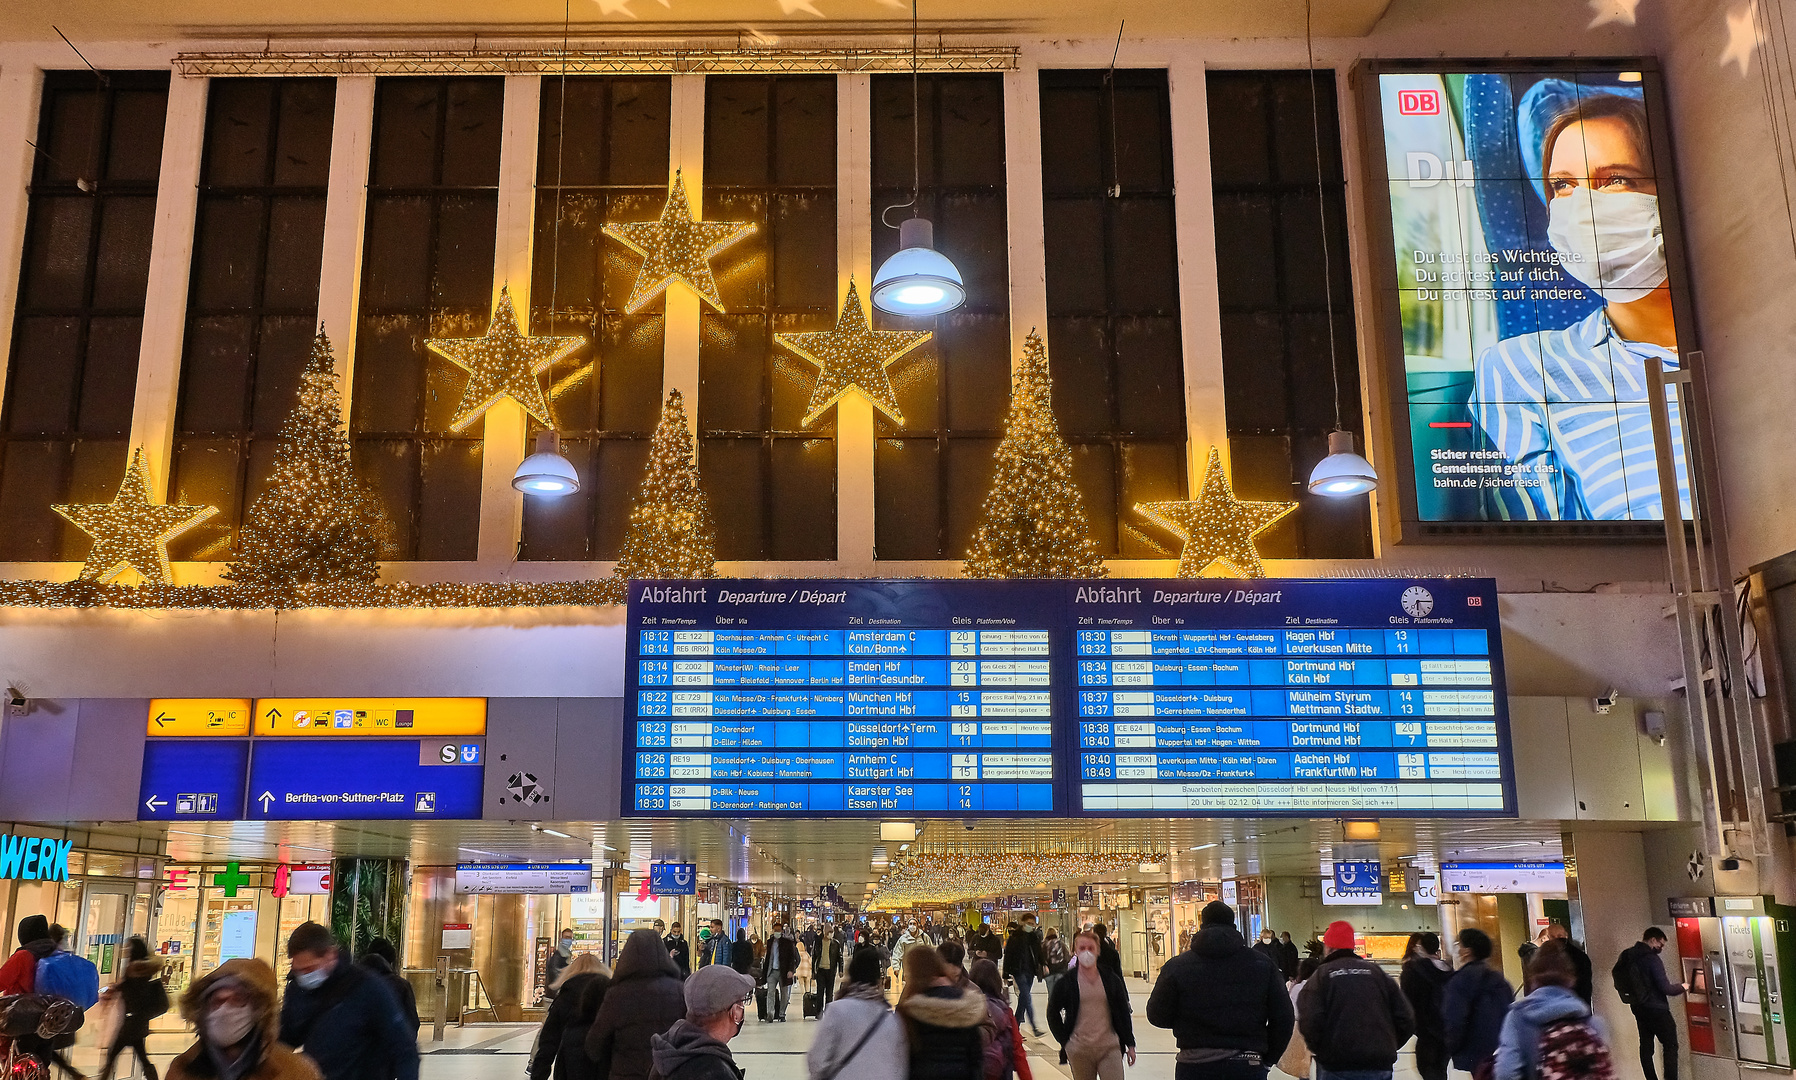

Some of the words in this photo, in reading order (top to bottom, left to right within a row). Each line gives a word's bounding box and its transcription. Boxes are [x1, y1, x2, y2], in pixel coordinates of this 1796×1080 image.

[1402, 92, 1438, 113] DB
[1406, 152, 1474, 188] Du
[1414, 251, 1434, 263] Du
[1440, 252, 1469, 263] tust
[1474, 251, 1498, 263] das
[1502, 250, 1586, 264] Wichtigste.
[1416, 270, 1436, 282] Du
[1442, 269, 1496, 282] achtest
[1500, 269, 1524, 282] auf
[1529, 268, 1564, 282] dich.
[1418, 288, 1438, 301] Du
[1443, 288, 1498, 301] achtest
[1502, 288, 1526, 300] auf
[1532, 287, 1586, 300] andere.
[1430, 449, 1467, 460] Sicher
[1470, 450, 1509, 459] reisen.
[1432, 464, 1502, 473] Gemeinsam
[1504, 463, 1531, 475] geht
[1534, 463, 1558, 473] das.
[1434, 478, 1476, 487] bahn.de
[1479, 477, 1546, 488] /sicherreisen
[640, 587, 706, 603] Abfahrt
[718, 590, 786, 605] Departure
[800, 590, 847, 605] Départ
[1075, 587, 1141, 603] Abfahrt
[1153, 590, 1221, 605] Departure
[1235, 590, 1281, 605] Départ
[1468, 597, 1481, 606] DB
[716, 616, 734, 624] Über
[1152, 616, 1170, 624] Über
[1390, 616, 1409, 624] Gleis
[643, 632, 668, 641] 18:12
[849, 632, 905, 641] Amsterdam
[910, 632, 916, 641] C
[957, 632, 968, 641] 20
[1080, 632, 1106, 641] 18:30
[1286, 632, 1315, 642] Hagen
[1318, 632, 1334, 640] Hbf
[1395, 632, 1406, 640] 13
[643, 645, 668, 653] 18:14
[963, 645, 968, 653] 5
[1080, 645, 1106, 653] 18:32
[1287, 644, 1342, 653] Leverkusen
[1346, 644, 1372, 653] Mitte
[1397, 645, 1408, 653] 11
[642, 662, 667, 671] 18:14
[849, 662, 881, 671] Emden
[884, 662, 900, 671] Hbf
[957, 663, 969, 671] 20
[1288, 662, 1335, 671] Dortmund
[1339, 662, 1355, 671] Hbf
[642, 675, 667, 683] 18:17
[849, 675, 928, 683] Berlin-Gesundbr.
[964, 675, 969, 683] 9
[1289, 674, 1311, 683] Köln
[1314, 674, 1330, 683] Hbf
[849, 692, 892, 702] München
[895, 693, 911, 702] Hbf
[1290, 692, 1331, 701] Mülheim
[1335, 692, 1371, 703] Styrum
[849, 705, 895, 715] Dortmund
[899, 705, 916, 715] Hbf
[1291, 705, 1341, 714] Mettmann
[1345, 705, 1383, 714] Stadtw.
[1292, 723, 1340, 732] Dortmund
[1343, 723, 1360, 732] Hbf
[849, 737, 889, 747] Solingen
[893, 737, 908, 745] Hbf
[1293, 736, 1341, 745] Dortmund
[1345, 736, 1361, 745] Hbf
[442, 745, 456, 762] S
[849, 755, 886, 764] Arnhem
[892, 755, 897, 764] C
[1295, 754, 1330, 764] Aachen
[1334, 754, 1350, 764] Hbf
[849, 768, 893, 778] Stuttgart
[897, 768, 913, 777] Hbf
[1295, 767, 1357, 777] Frankfurt(M)
[1361, 767, 1377, 776] Hbf
[848, 786, 892, 795] Kaarster
[895, 786, 913, 795] See
[286, 793, 404, 803] Bertha-von-Suttner-Platz
[848, 799, 877, 808] Essen
[881, 799, 897, 808] Hbf
[1, 834, 72, 881] WERK
[822, 886, 828, 896] 4
[1059, 890, 1064, 898] 5
[1085, 887, 1091, 896] 4
[1729, 925, 1750, 934] Tickets
